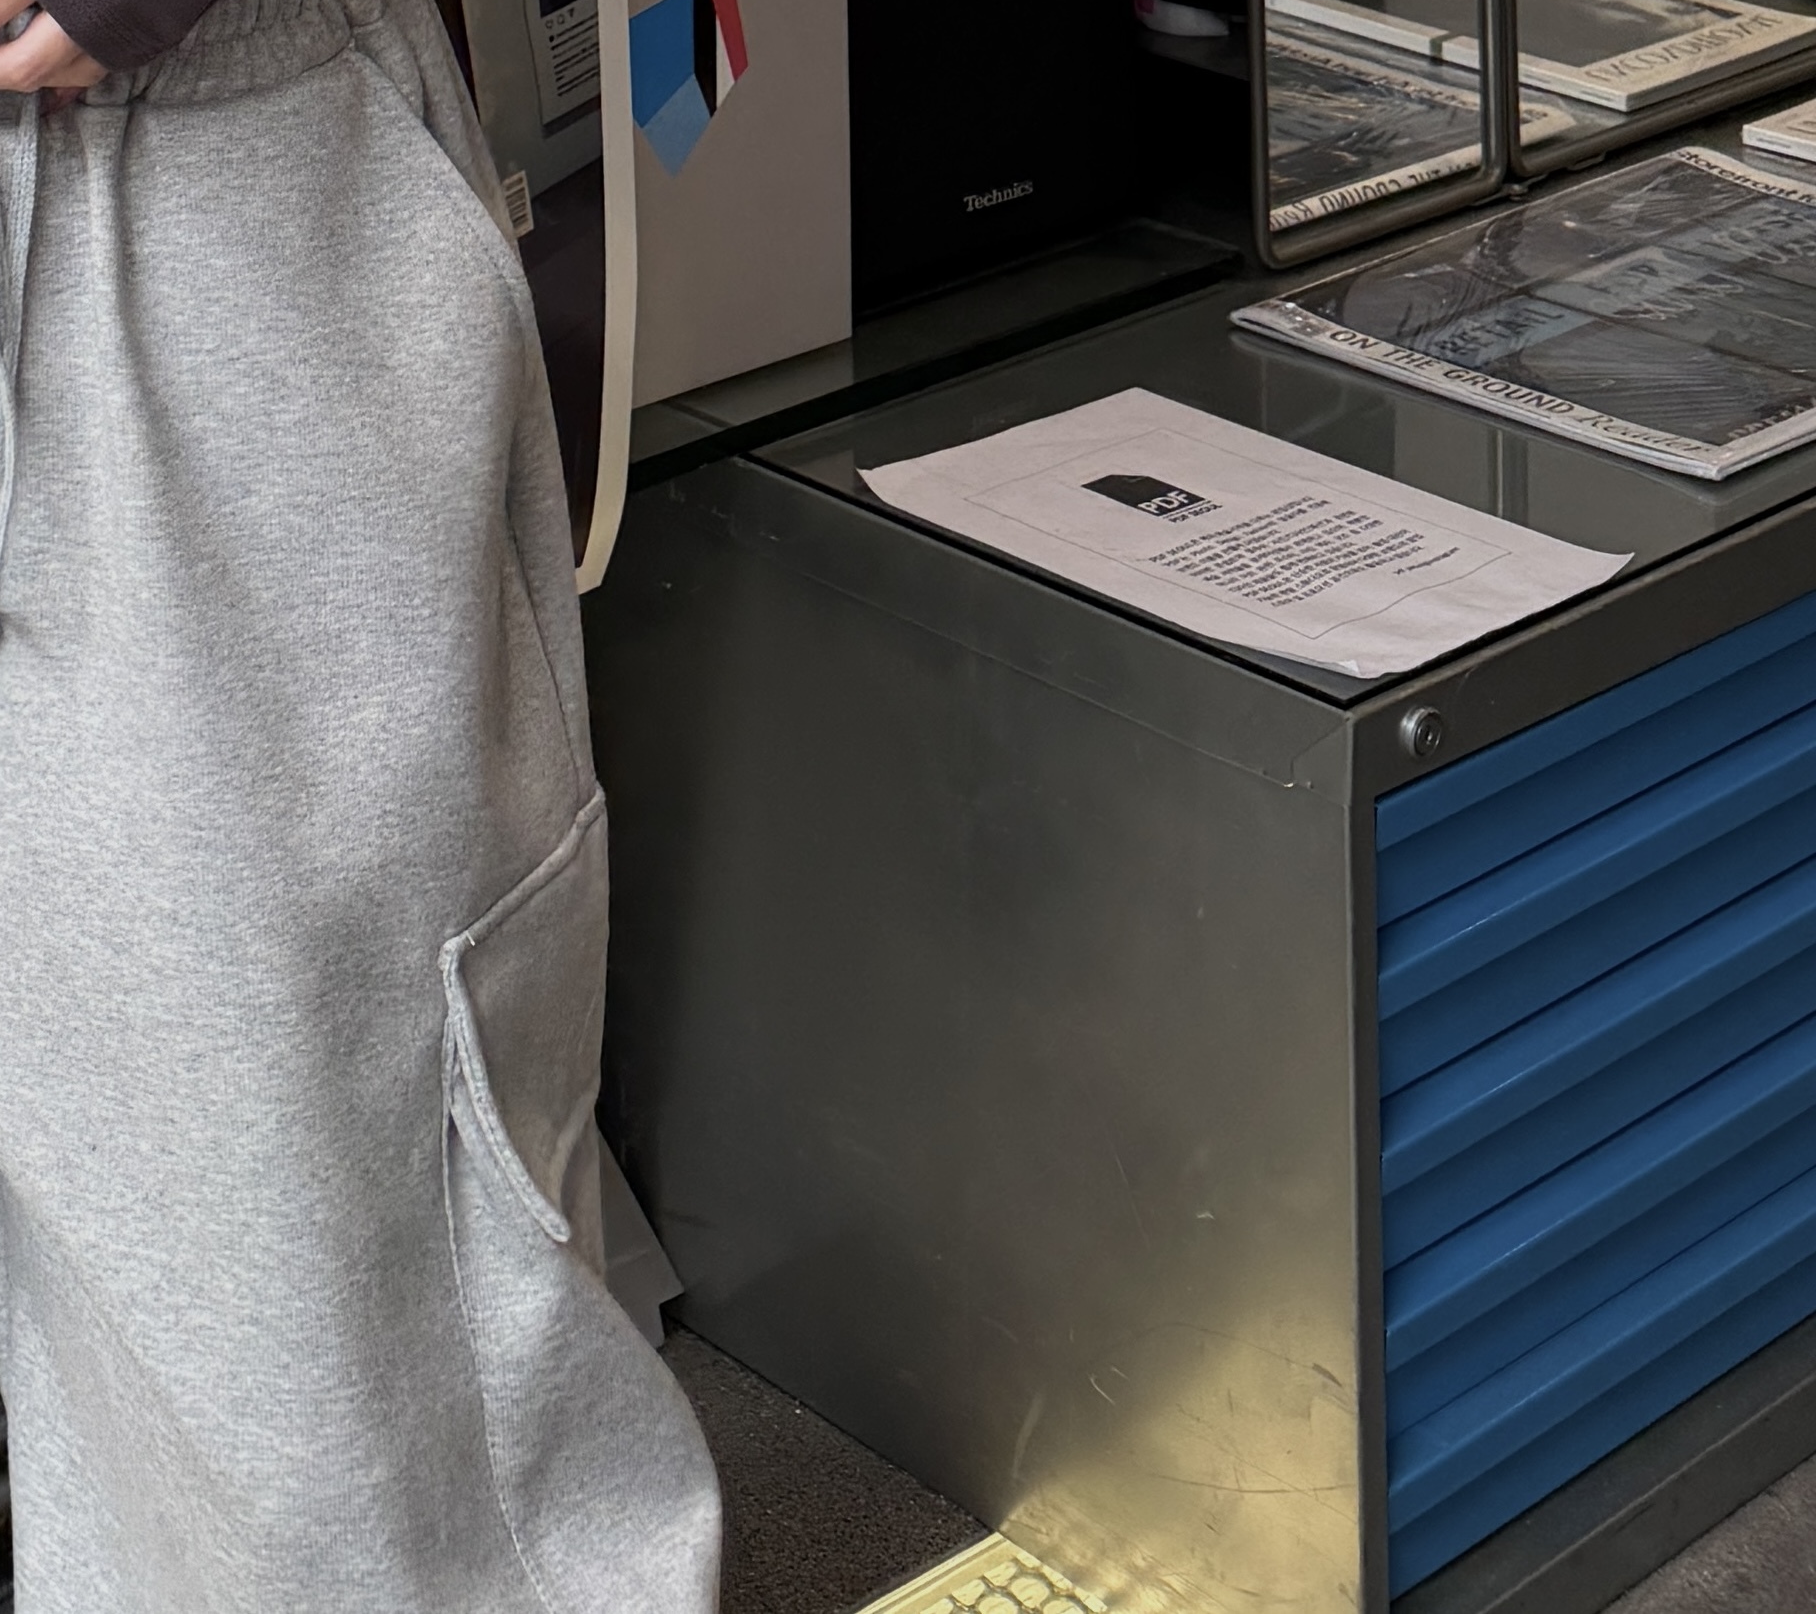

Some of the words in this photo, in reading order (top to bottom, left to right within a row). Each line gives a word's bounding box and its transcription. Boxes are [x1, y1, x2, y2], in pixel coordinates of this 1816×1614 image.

[963, 179, 1035, 213] Technics
[1329, 328, 1378, 352] ON
[1383, 347, 1435, 373] THE
[1443, 367, 1576, 415] GROUND
[1137, 489, 1190, 515] PDF
